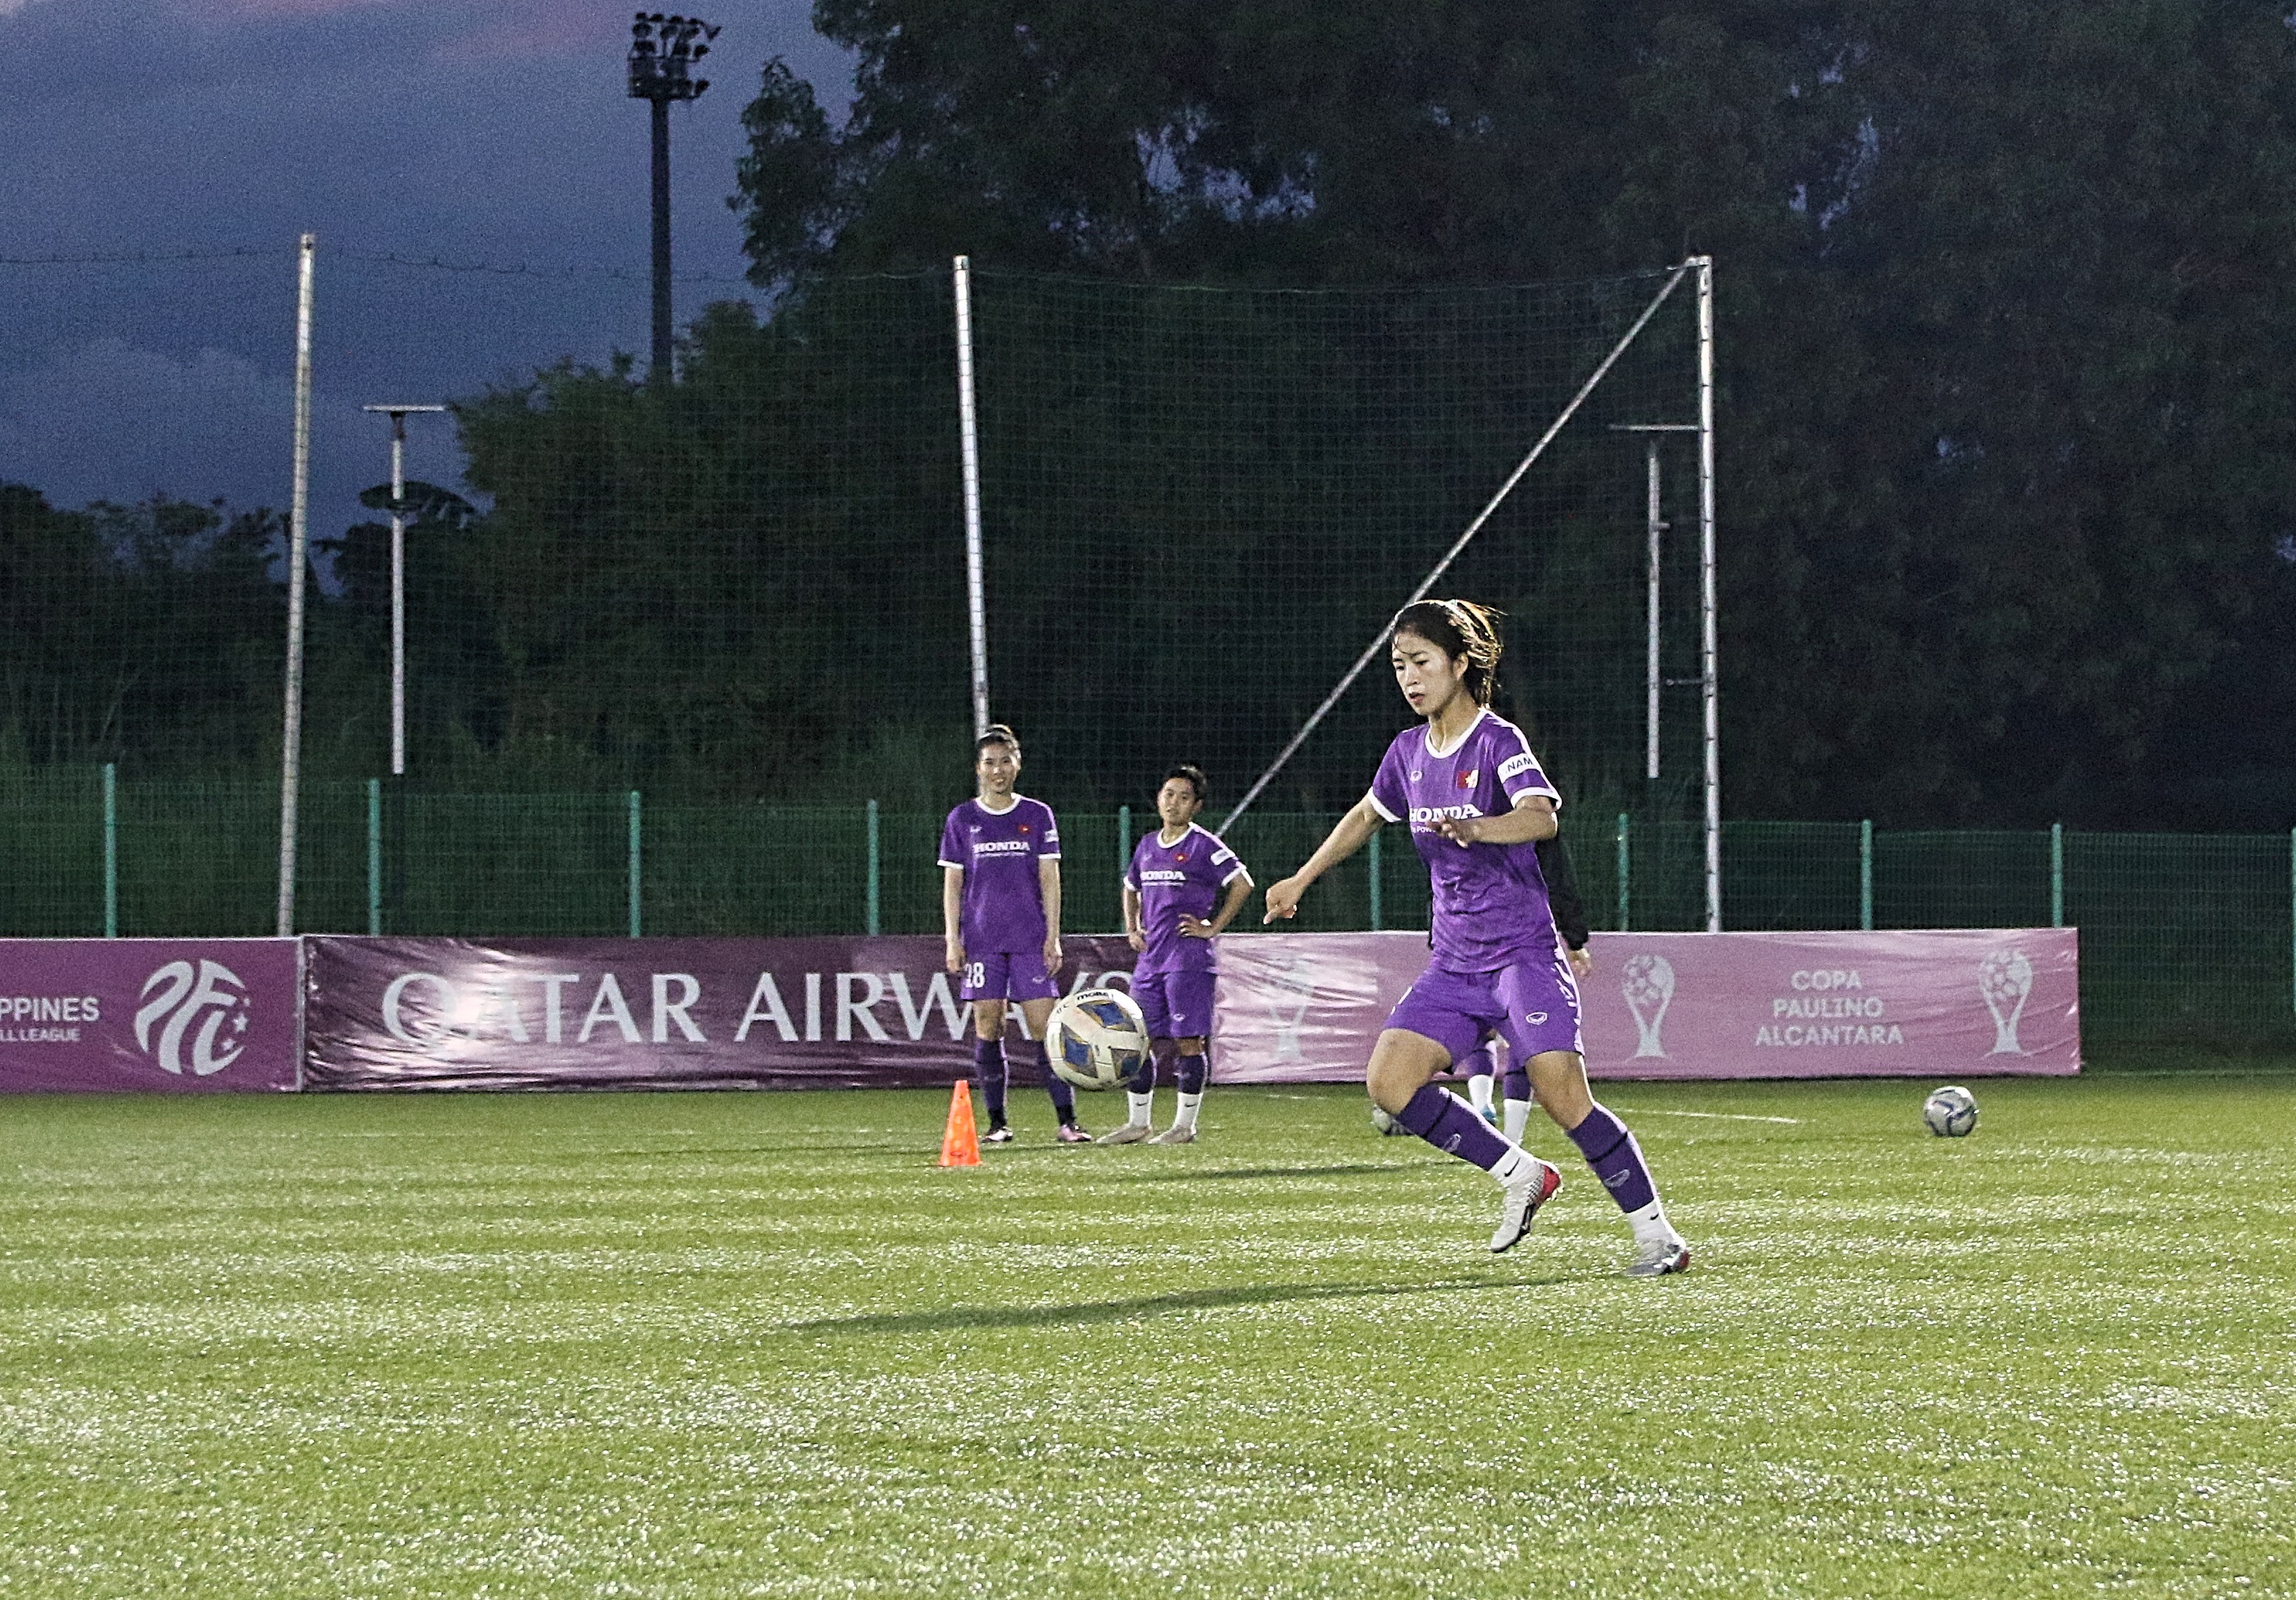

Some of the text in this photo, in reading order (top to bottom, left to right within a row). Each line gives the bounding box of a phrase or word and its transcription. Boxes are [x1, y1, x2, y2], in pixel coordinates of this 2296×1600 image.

[1409, 803, 1484, 822] HONDA
[973, 841, 1030, 853] HONDA
[1791, 969, 1862, 991] COPA
[0, 996, 99, 1021] PPINES
[382, 971, 1133, 1060] QATAR AIRWA
[1773, 997, 1883, 1018] PAULINO
[20, 1028, 81, 1042] LEAGUE
[1755, 1025, 1904, 1047] ALCANTARA
